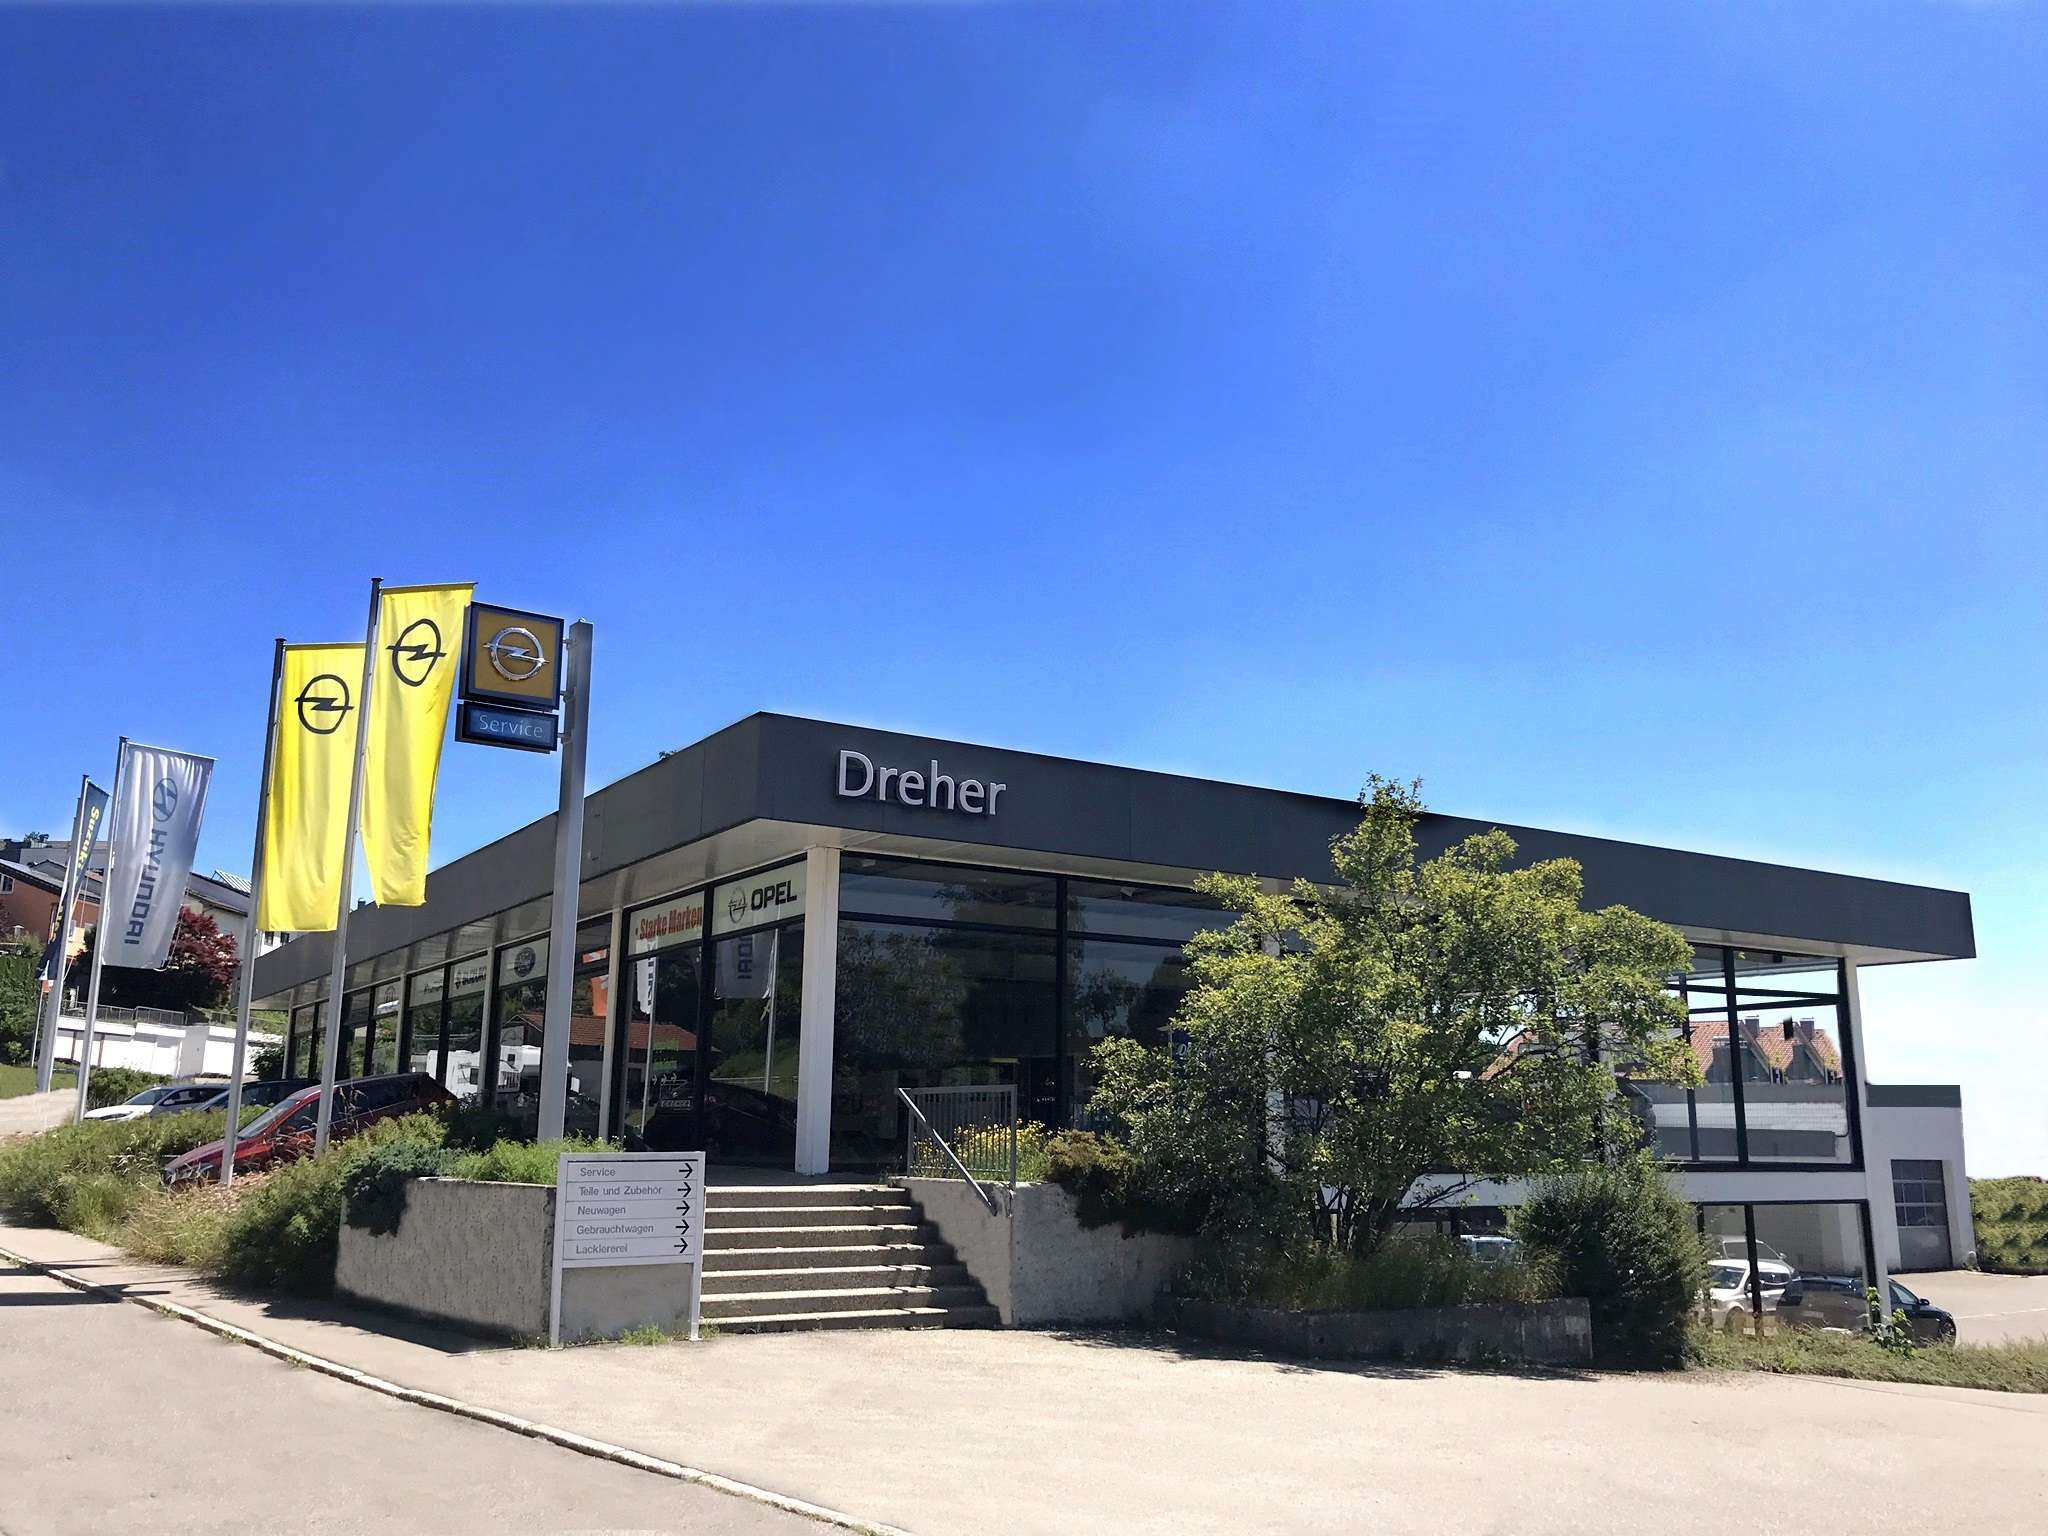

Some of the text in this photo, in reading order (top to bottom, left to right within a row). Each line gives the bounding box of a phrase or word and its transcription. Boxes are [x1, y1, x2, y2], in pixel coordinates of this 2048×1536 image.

[479, 714, 543, 737] Service
[838, 749, 1007, 816] Dreher
[124, 828, 168, 945] HYUNDAI
[750, 880, 798, 911] OPEL
[640, 906, 704, 940] Starke Marken
[580, 1167, 616, 1177] Service
[579, 1186, 599, 1196] Teile
[603, 1186, 621, 1196] und
[577, 1206, 626, 1216] Neuwagen
[576, 1224, 654, 1235] Gebrauchtwagen
[576, 1243, 628, 1254] Lackiererei
